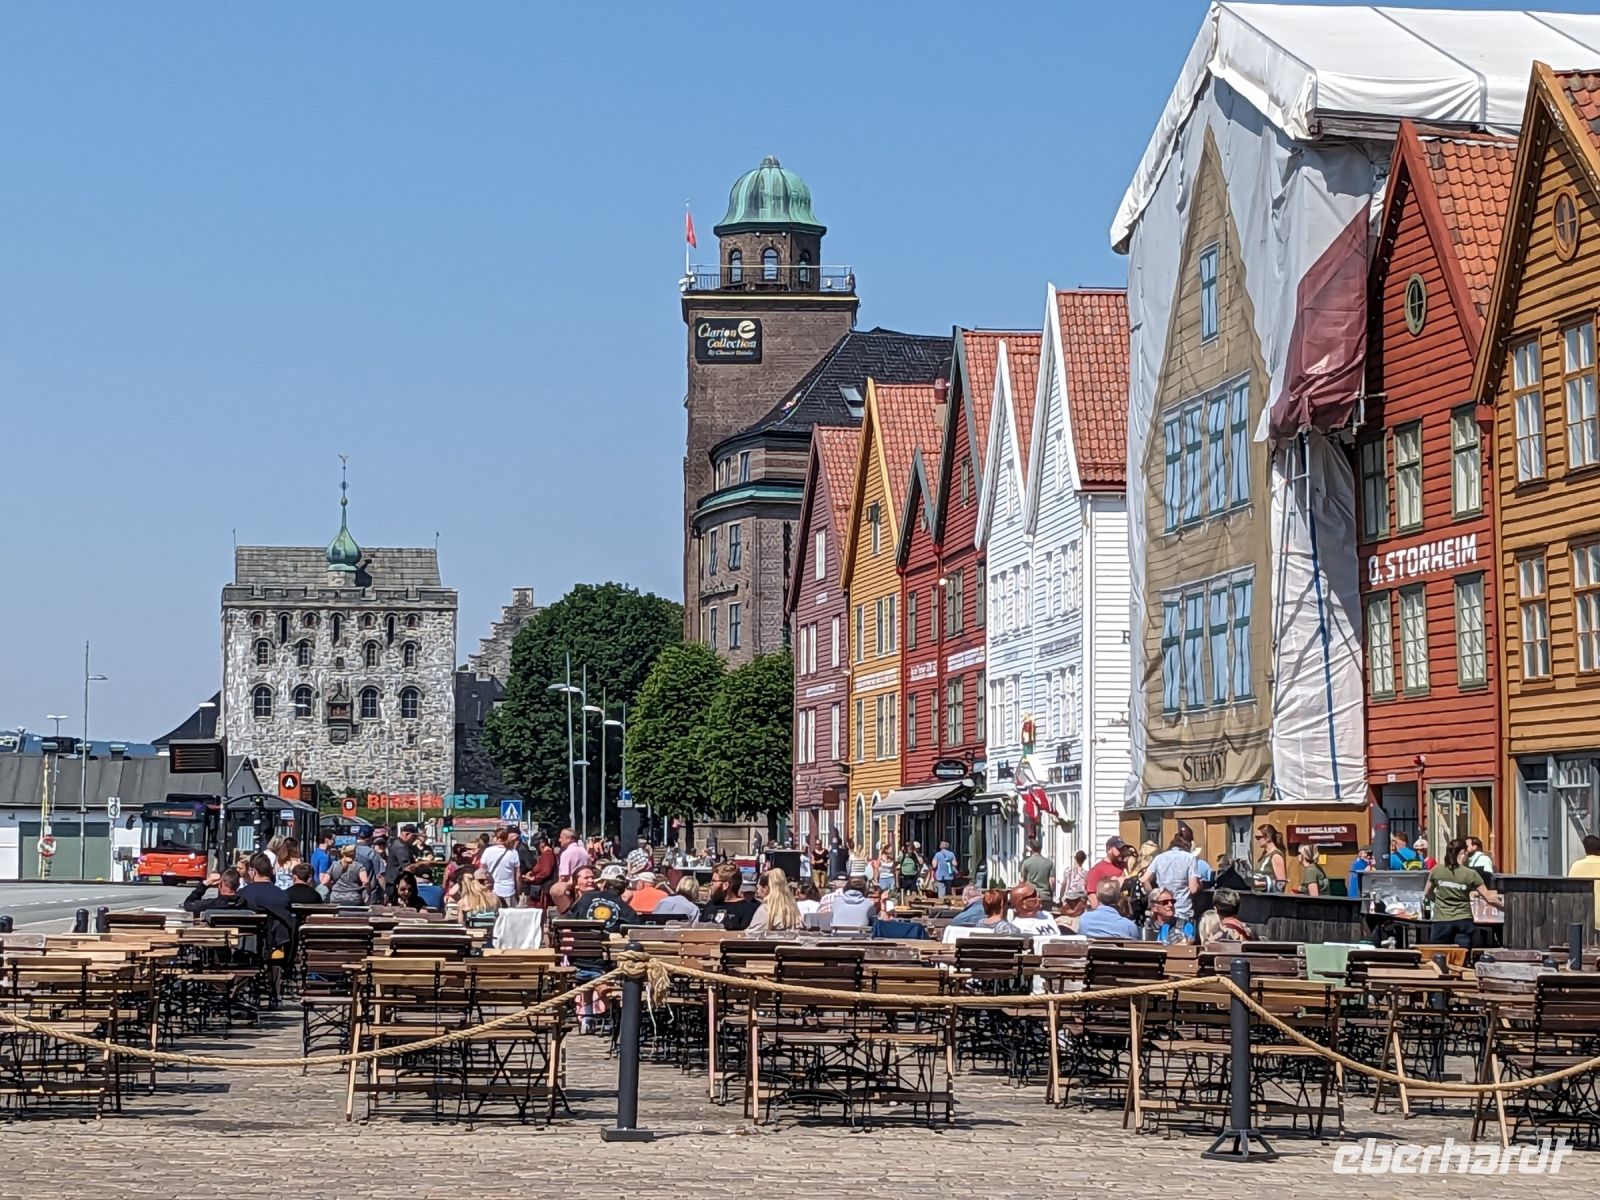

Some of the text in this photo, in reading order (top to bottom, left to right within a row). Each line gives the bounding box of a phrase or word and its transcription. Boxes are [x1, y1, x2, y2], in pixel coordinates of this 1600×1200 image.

[698, 323, 737, 338] Clarion
[707, 338, 757, 348] Collection
[285, 777, 294, 788] A
